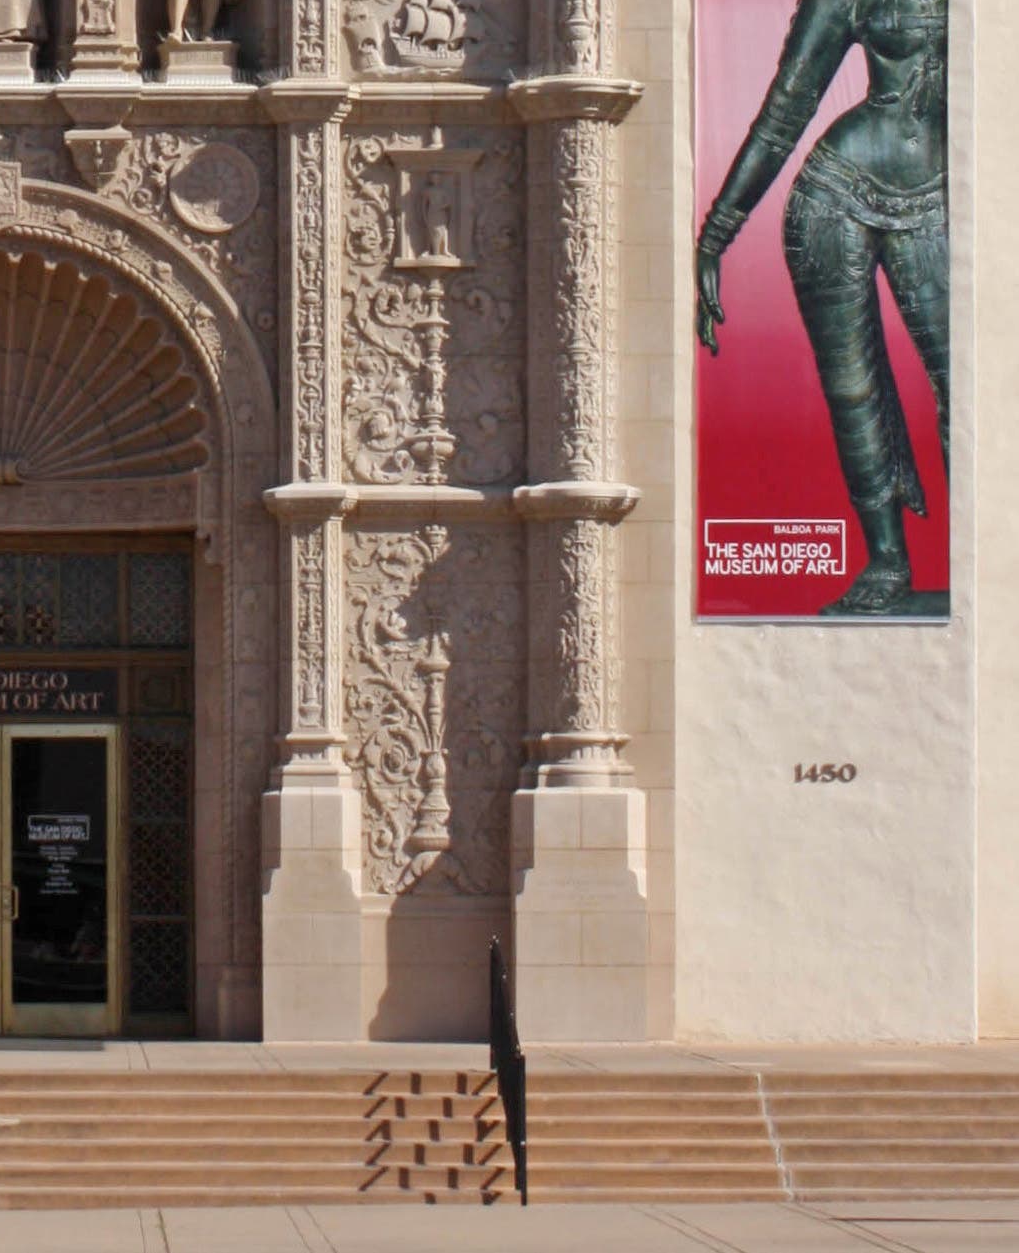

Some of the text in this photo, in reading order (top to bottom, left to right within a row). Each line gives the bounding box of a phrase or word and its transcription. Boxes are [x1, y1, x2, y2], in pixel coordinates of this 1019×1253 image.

[774, 525, 840, 534] BALBOA PARK
[708, 543, 831, 558] THE SAN DIEGO
[706, 560, 838, 575] MUSEUM OF ART
[13, 693, 47, 710] OF
[52, 692, 104, 710] ART
[793, 762, 857, 783] 1450
